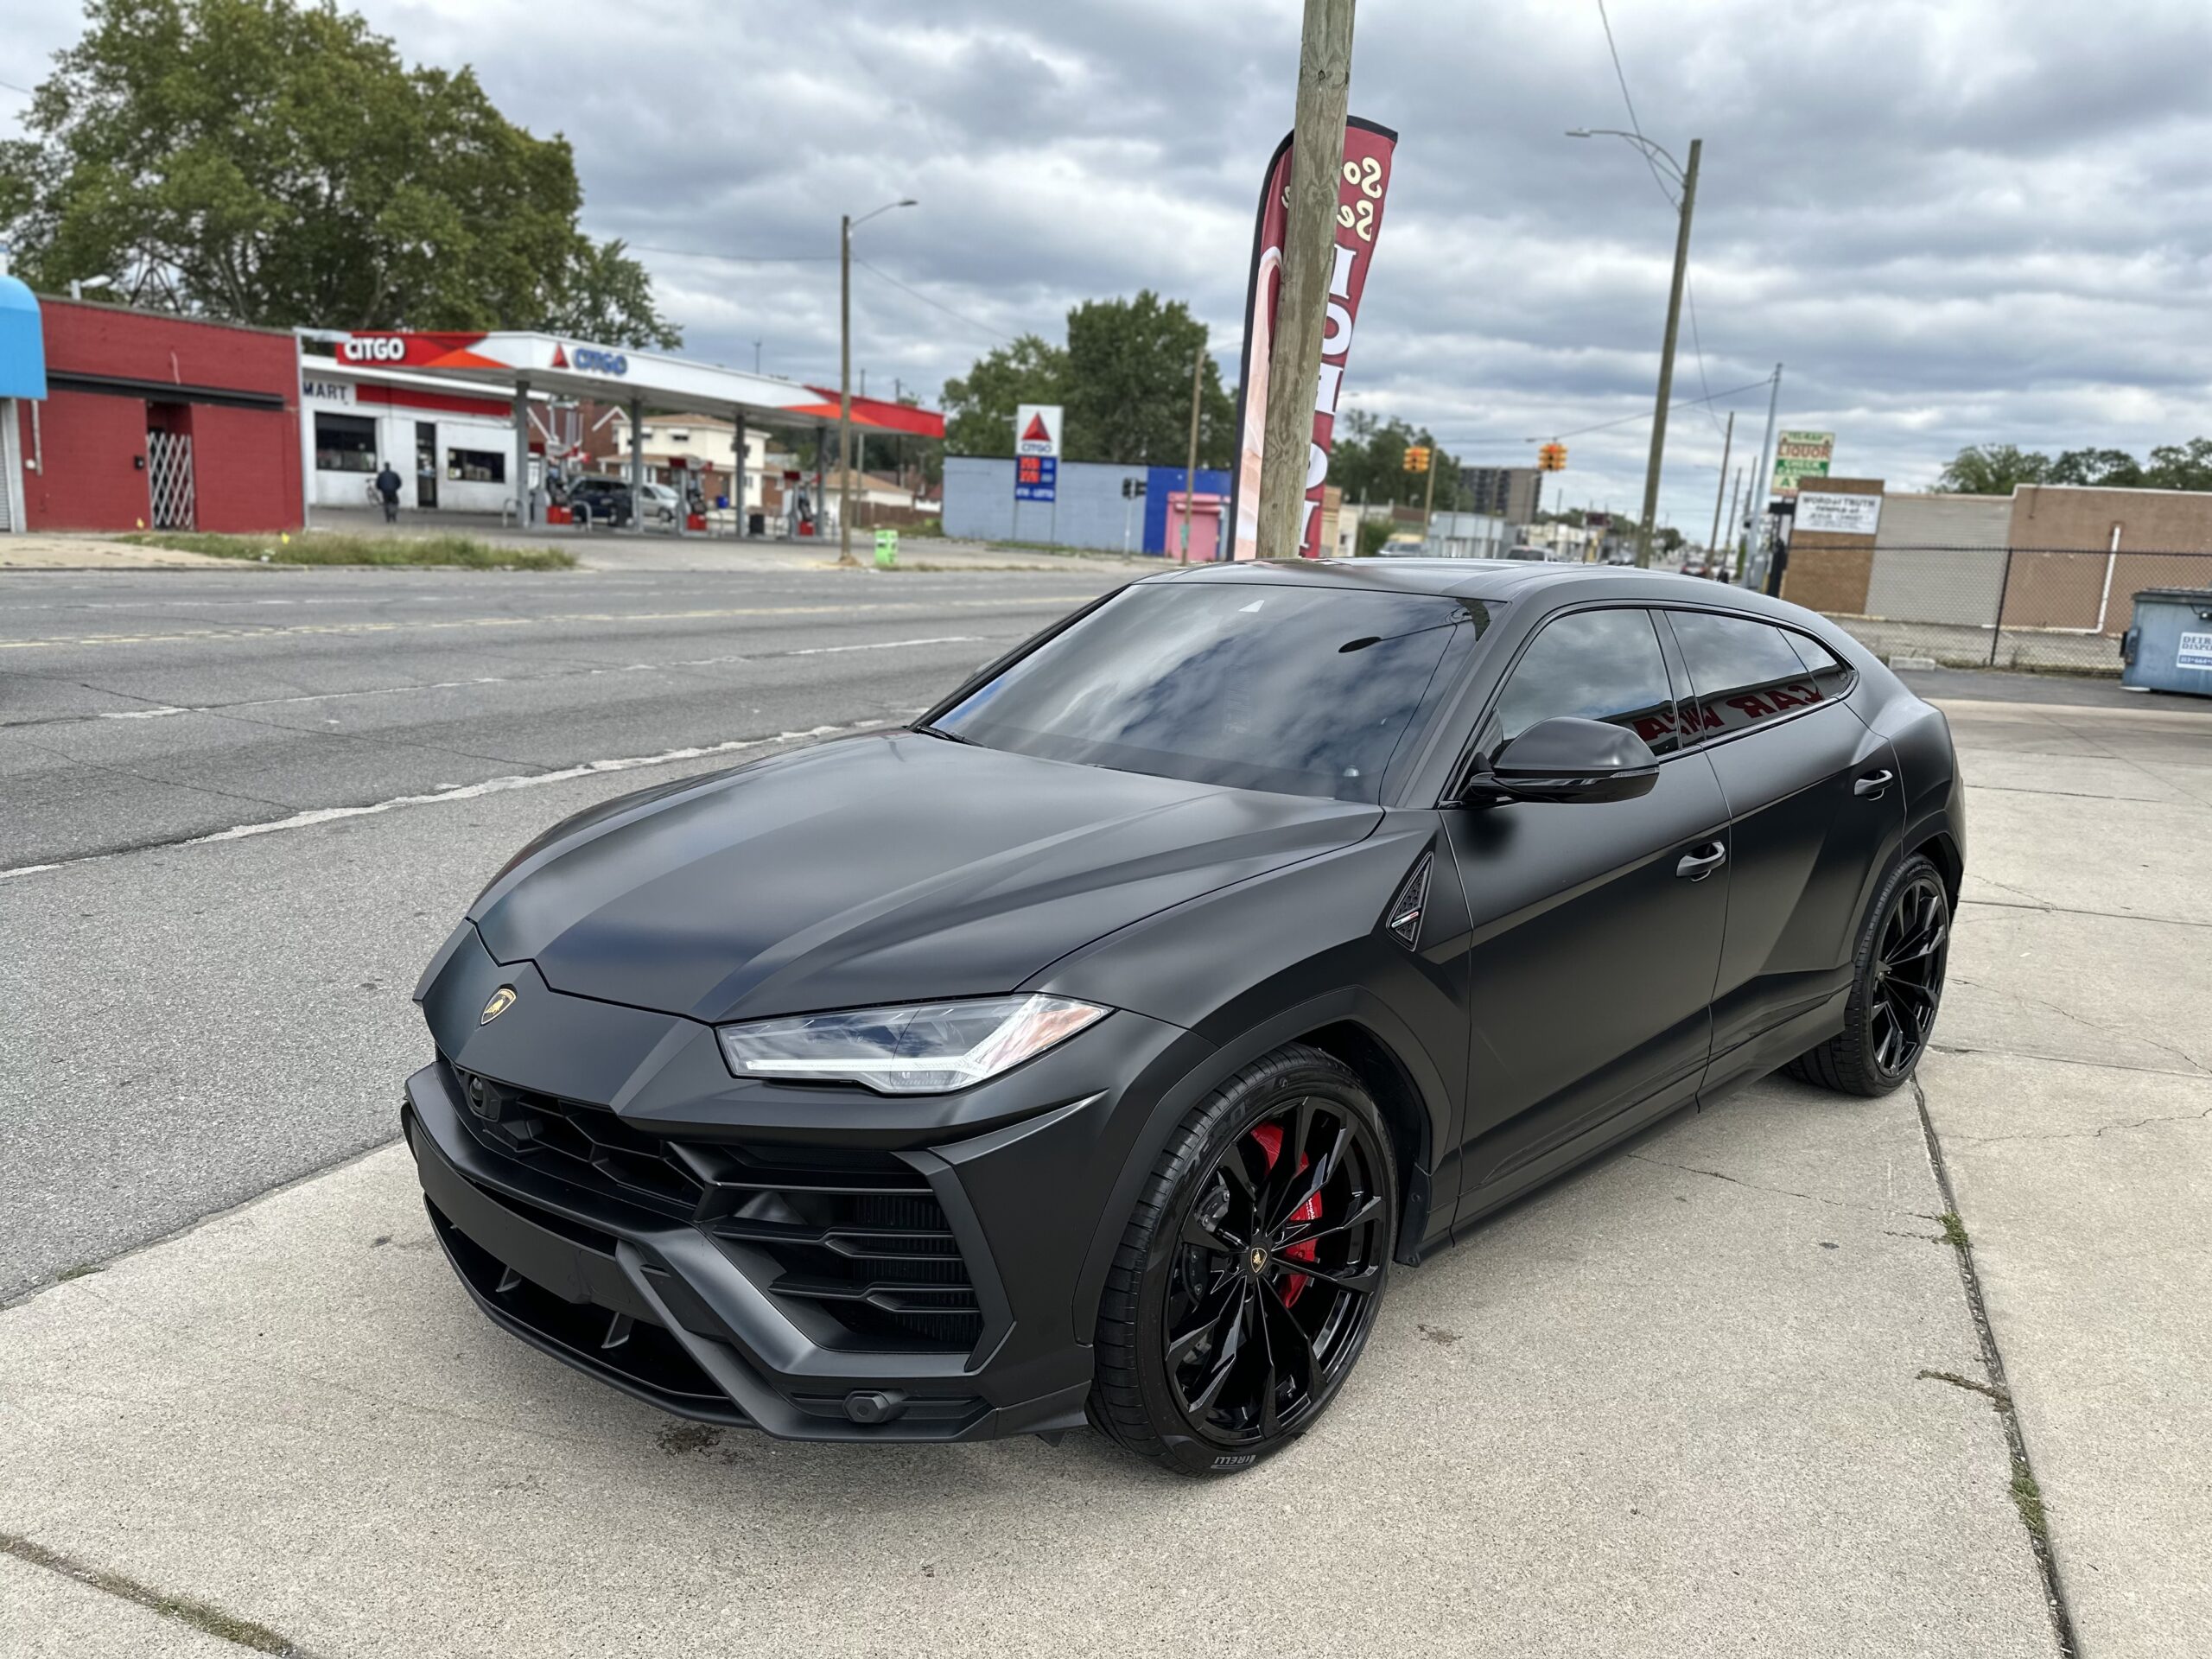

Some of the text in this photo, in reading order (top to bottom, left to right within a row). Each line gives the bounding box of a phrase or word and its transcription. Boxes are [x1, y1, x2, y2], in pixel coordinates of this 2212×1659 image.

[344, 337, 405, 360] CITGO
[573, 347, 628, 375] CITGO
[303, 382, 346, 400] MART
[1022, 443, 1052, 453] CITGO
[1779, 445, 1829, 458] LIQUOR
[1844, 498, 1876, 507] TRUTH
[1211, 1454, 1256, 1469] PIRELLI
